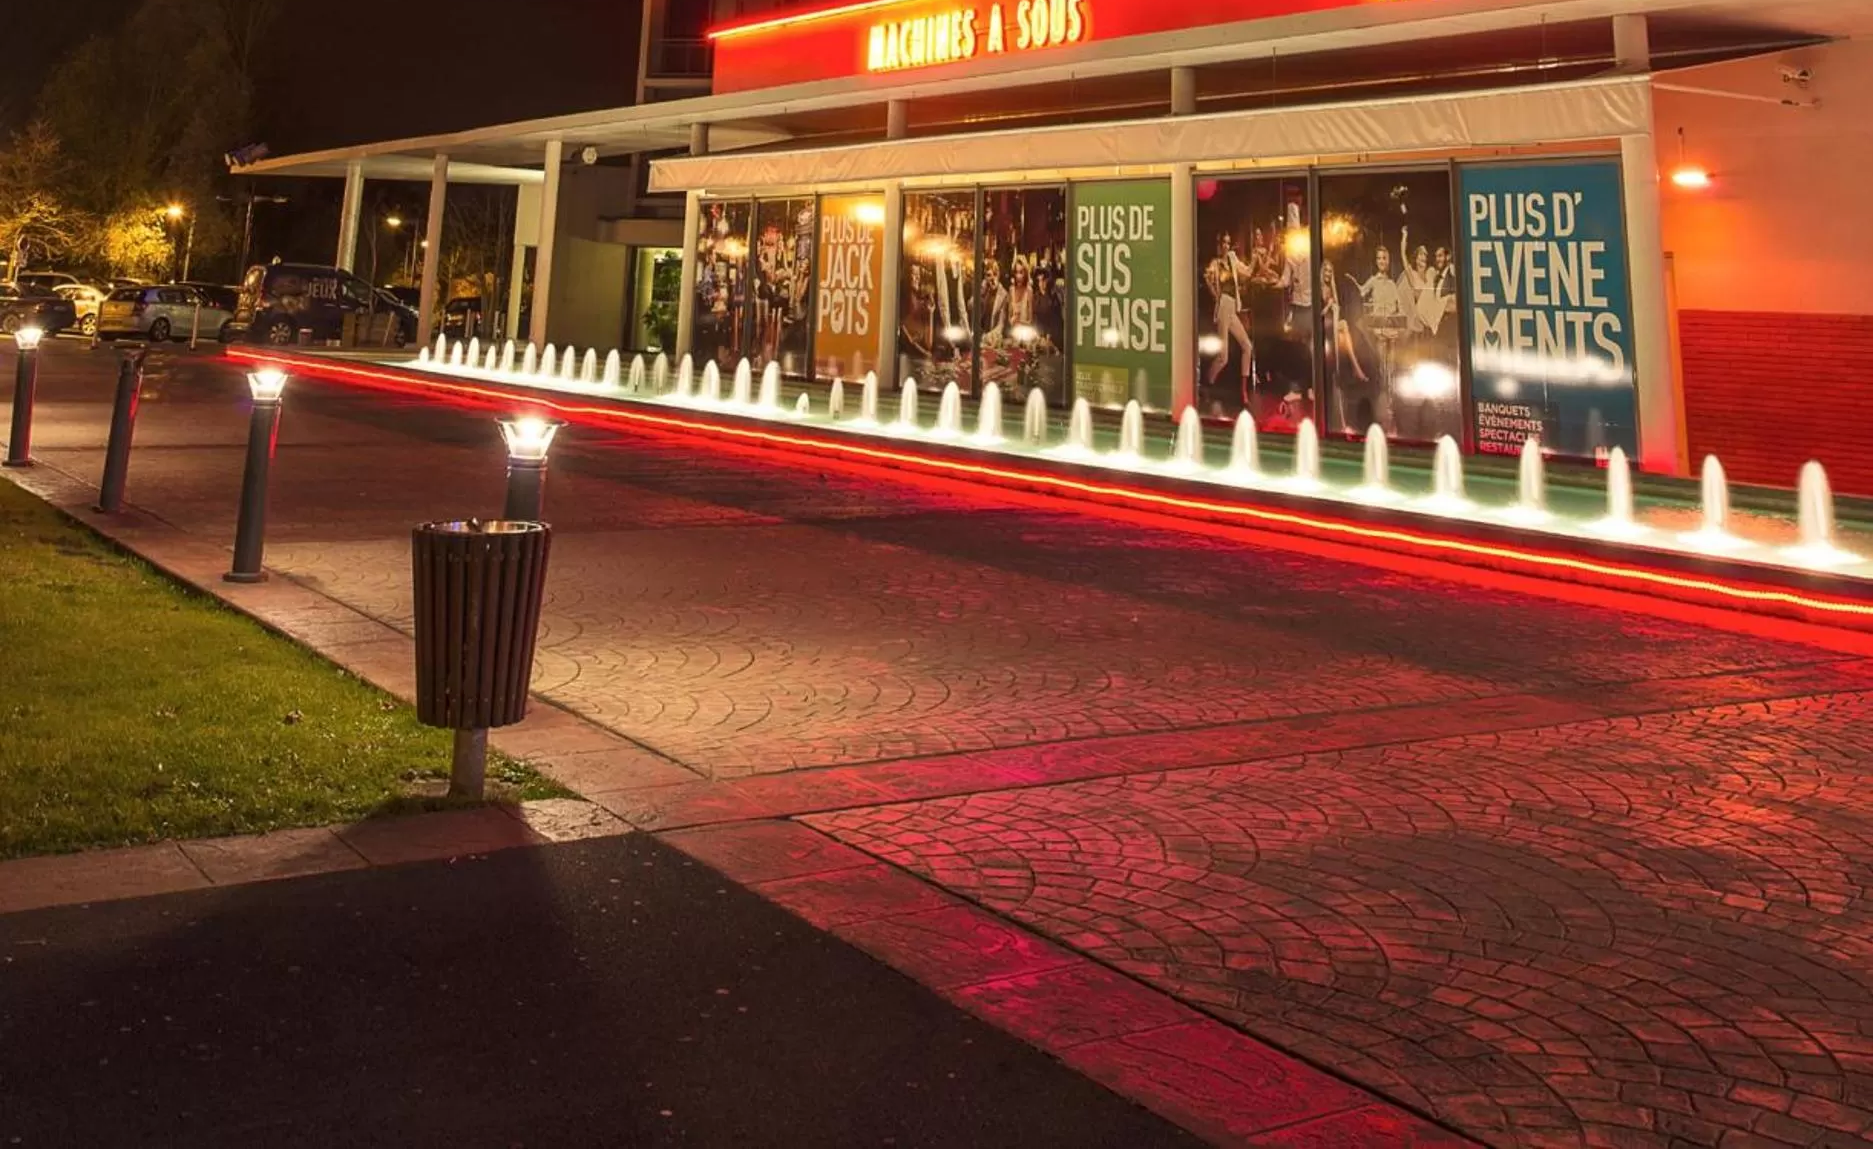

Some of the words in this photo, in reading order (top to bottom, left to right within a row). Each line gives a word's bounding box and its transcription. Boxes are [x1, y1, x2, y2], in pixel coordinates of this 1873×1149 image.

[868, 8, 975, 72] MACHINES
[987, 2, 1005, 53] A
[821, 215, 854, 244] PLUS
[857, 220, 875, 244] DE
[1076, 205, 1125, 241] PLUS
[1129, 205, 1154, 241] DE
[1469, 192, 1547, 238] PLUS
[1552, 192, 1583, 238] D'
[819, 244, 874, 289] JACK
[1076, 242, 1132, 294] SUS
[817, 288, 870, 336] POTS
[1076, 296, 1167, 352] PENSE
[1473, 307, 1625, 381] MENTS
[1478, 402, 1530, 417] BANQUETS
